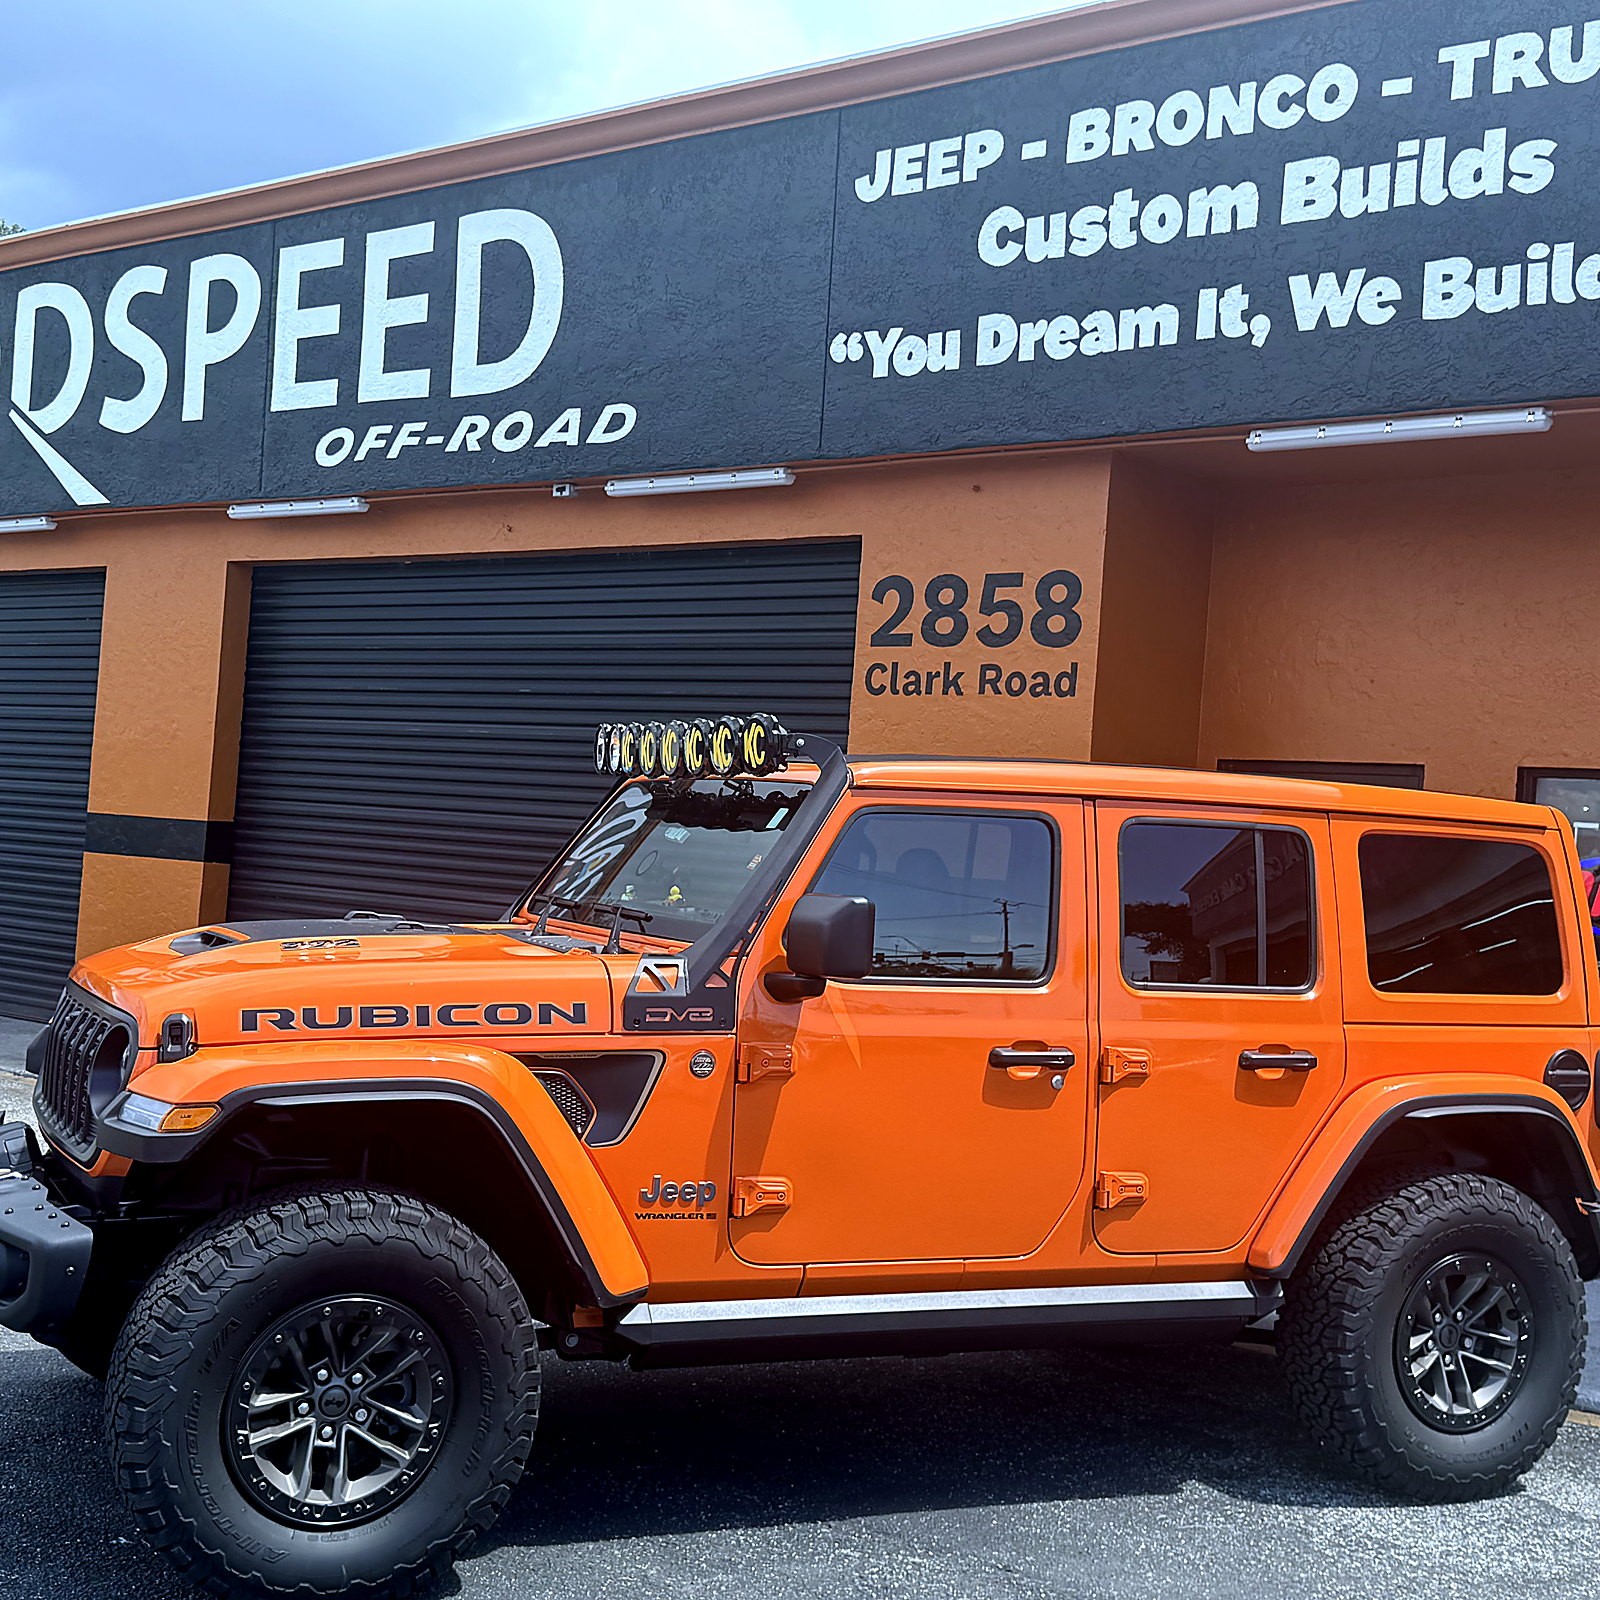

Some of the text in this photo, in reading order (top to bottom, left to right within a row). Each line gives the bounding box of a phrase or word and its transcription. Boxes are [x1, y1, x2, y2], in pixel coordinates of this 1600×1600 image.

[855, 129, 1004, 203] JEEP
[1065, 63, 1359, 165] BRONCO
[1437, 20, 1600, 101] TRU
[977, 128, 1558, 268] Custom Builds
[975, 304, 1179, 367] Dream
[1196, 287, 1271, 349] It,
[1288, 268, 1402, 331] We
[314, 403, 637, 467] OFF-ROAD
[870, 570, 1082, 648] 2858
[864, 662, 1079, 698] Clark Road
[621, 730, 634, 769] KC
[641, 729, 654, 771] KC
[662, 728, 677, 771] KC
[685, 727, 703, 771] KC
[712, 725, 732, 770] KC
[743, 722, 765, 769] KC
[240, 1002, 588, 1032] RUBICON
[640, 1174, 717, 1207] Jeep
[634, 1212, 705, 1220] WRANGLER
